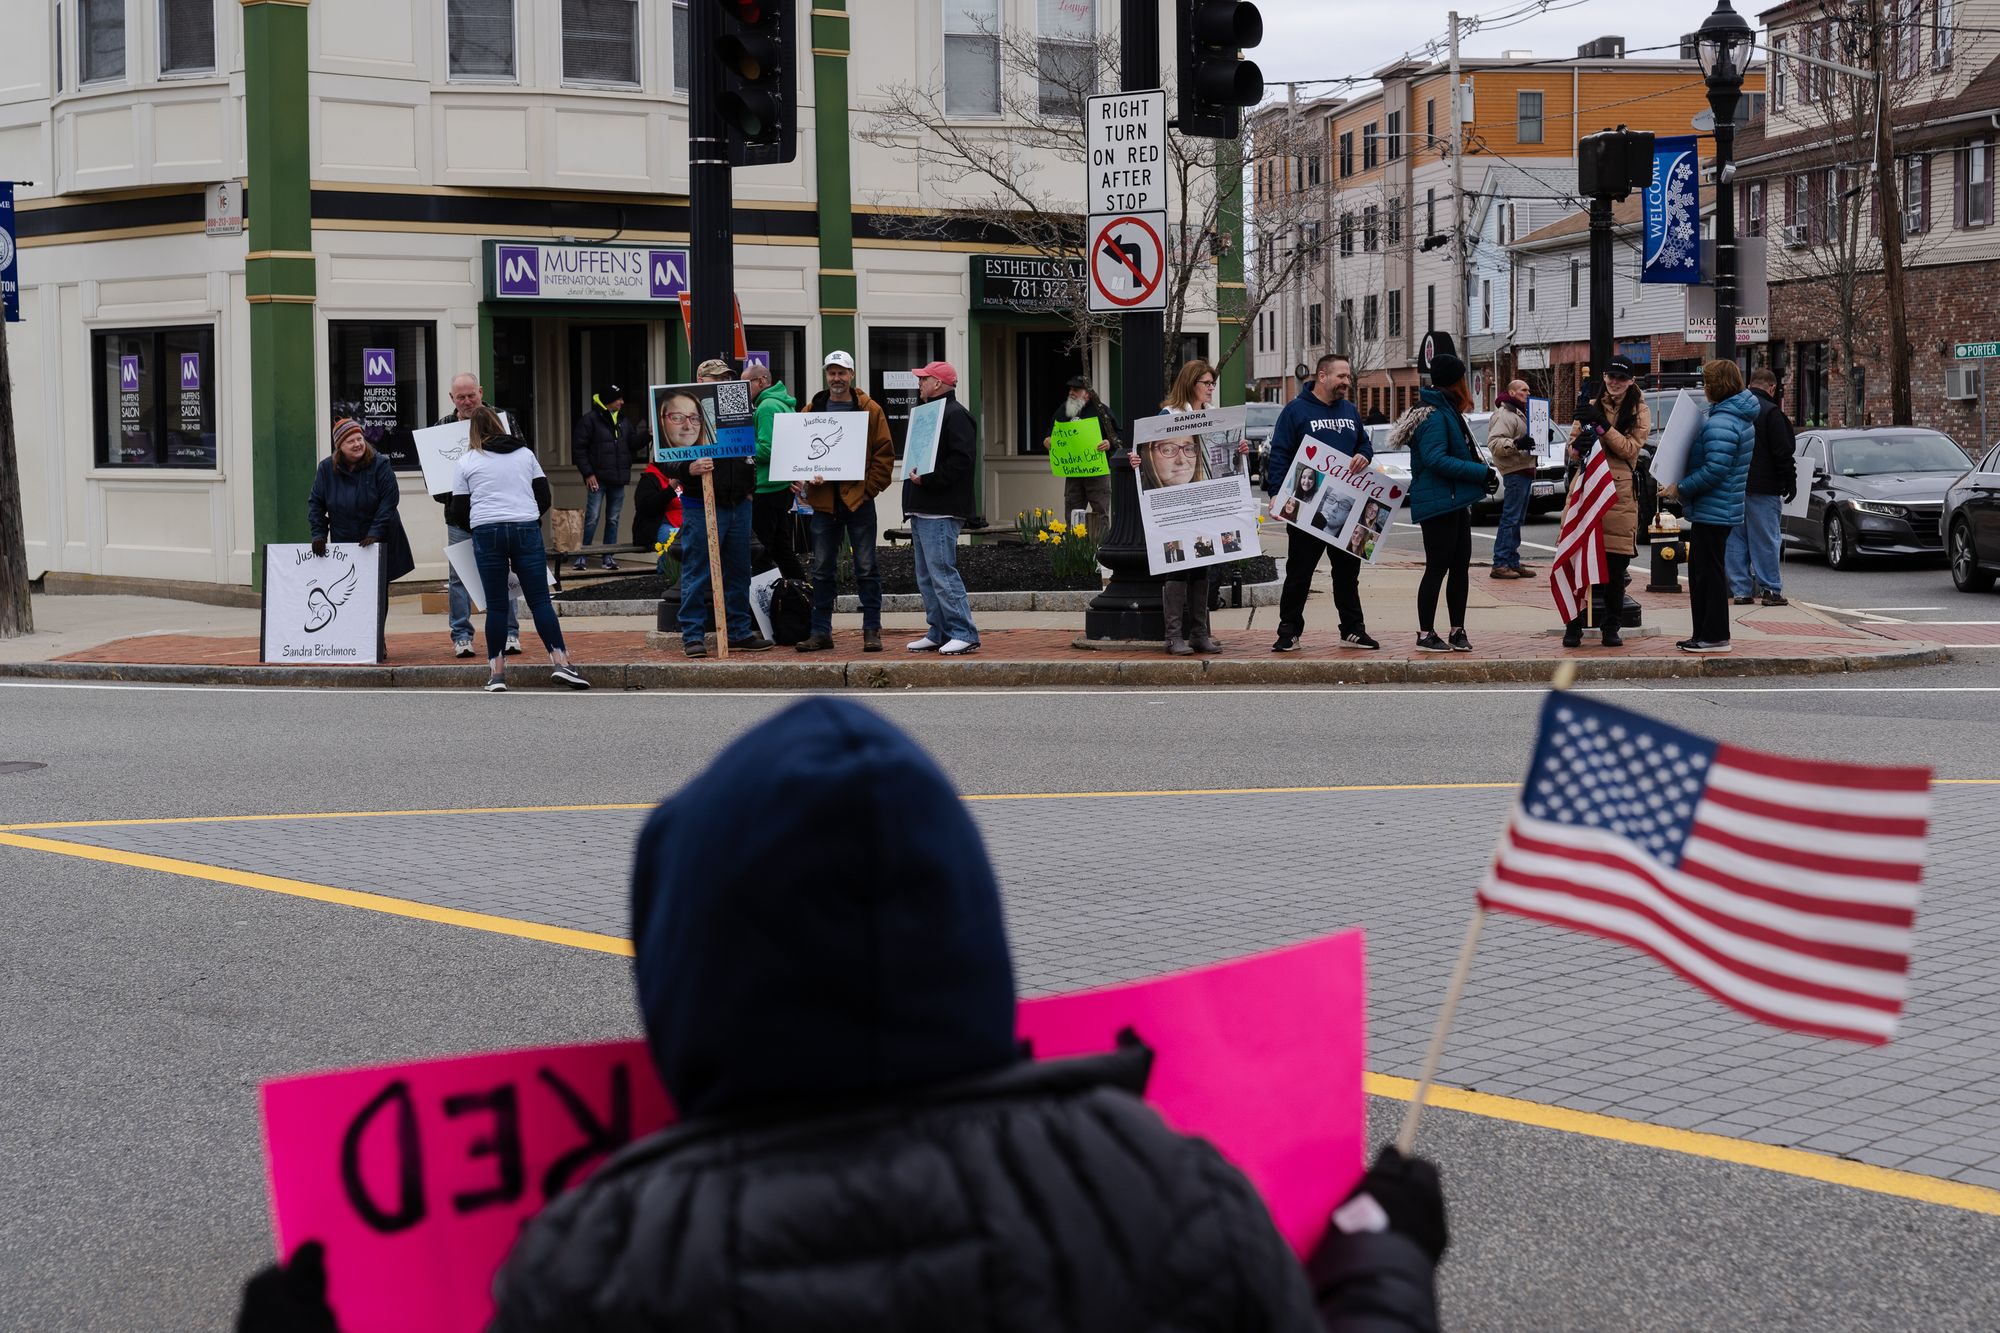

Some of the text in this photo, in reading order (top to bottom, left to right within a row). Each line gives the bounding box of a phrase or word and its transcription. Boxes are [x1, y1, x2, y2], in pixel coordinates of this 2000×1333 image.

[1102, 100, 1149, 119] RIGHT
[1105, 123, 1147, 142] TURN
[1094, 145, 1159, 166] ON RED
[1102, 169, 1151, 189] AFTER
[1106, 192, 1148, 211] STOP
[544, 250, 642, 274] MUFFEN'S
[985, 260, 1051, 276] ESTHETIC
[544, 275, 643, 286] INTERNATIONAL SALON
[1967, 345, 1997, 356] PORTER
[364, 388, 397, 397] MUFFEN'S
[121, 407, 140, 418] SALON
[181, 406, 201, 417] SALON
[364, 402, 397, 413] SALON
[804, 416, 838, 427] Justice for
[1174, 412, 1207, 423] SANDRA
[1166, 420, 1214, 433] BIRCHMORE
[1310, 418, 1355, 433] PATRIOTS
[659, 448, 698, 460] SANDRA
[814, 464, 841, 472] Birchmore
[1317, 454, 1385, 499] Sandra
[332, 545, 348, 562] for
[282, 644, 357, 657] Sandra Birchmore
